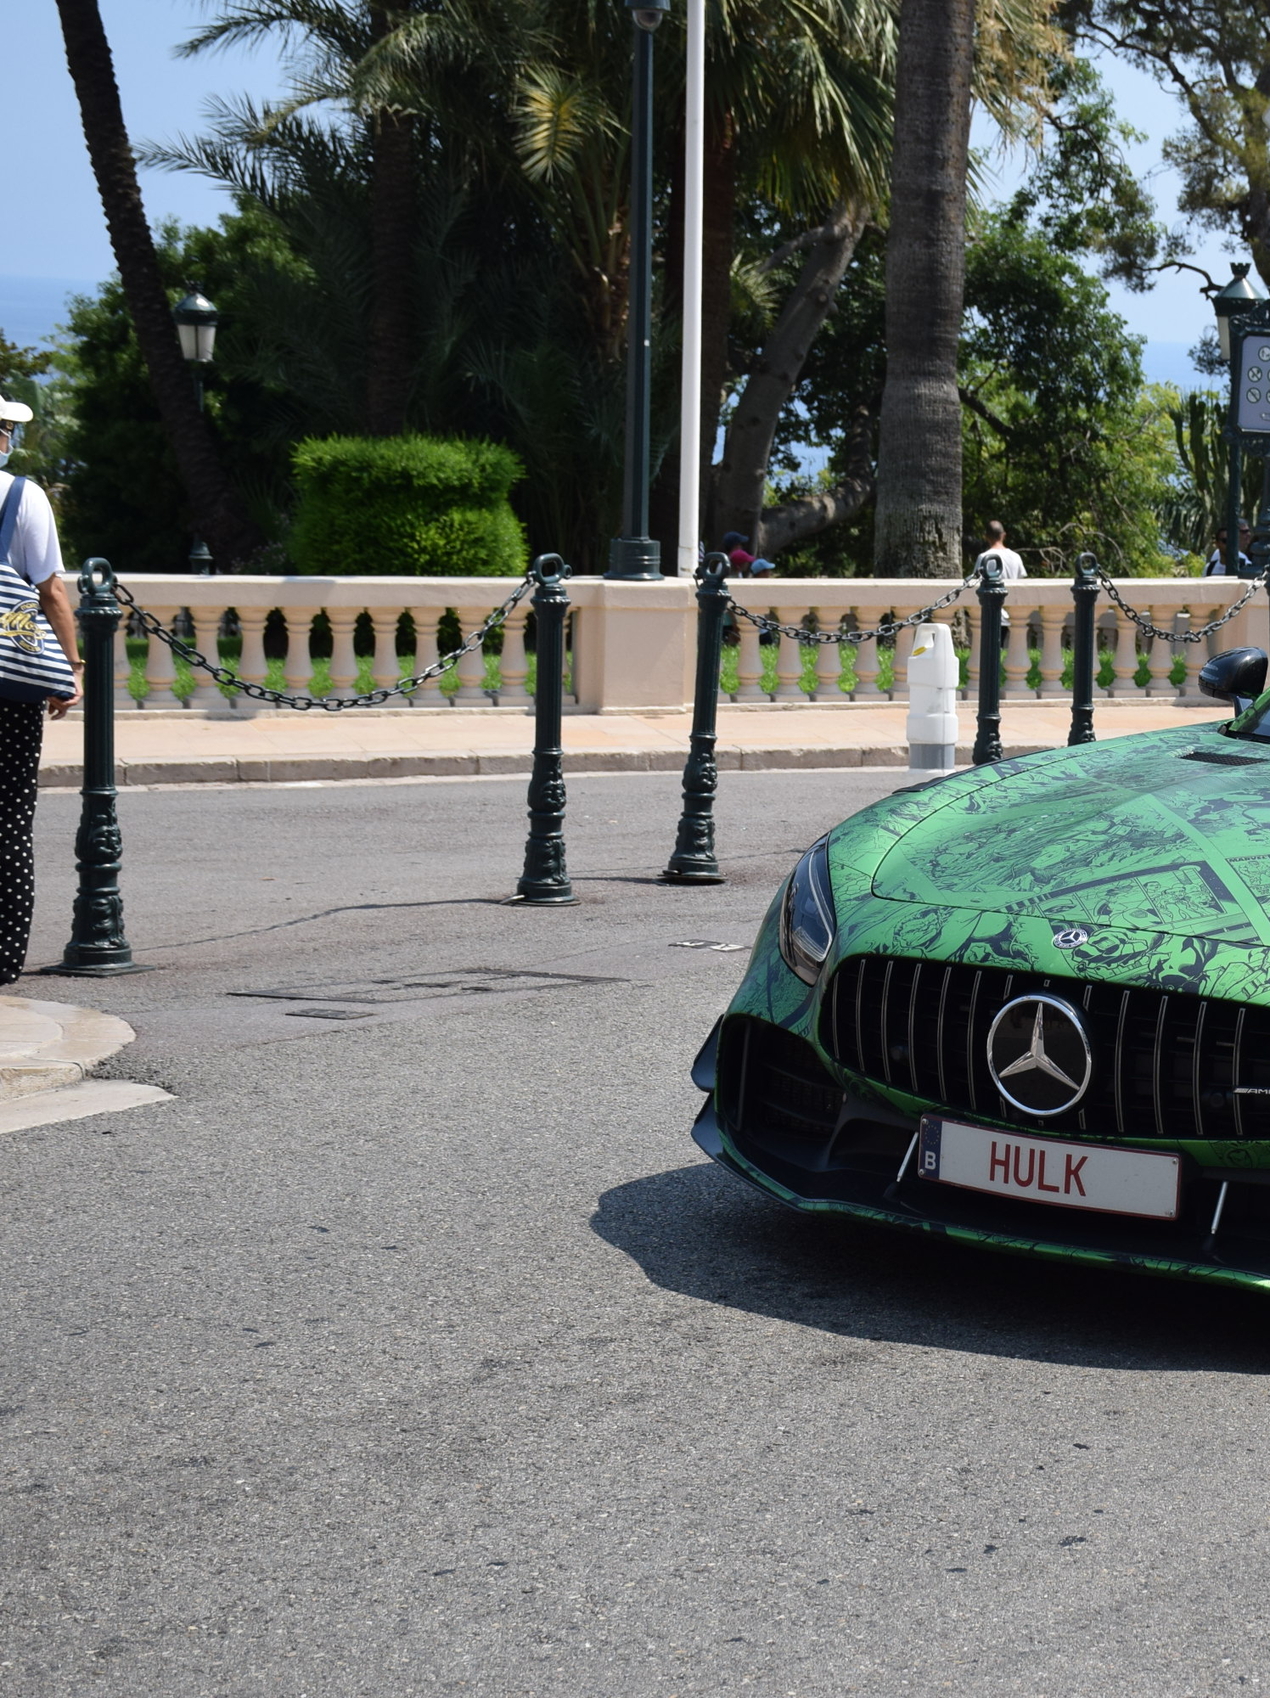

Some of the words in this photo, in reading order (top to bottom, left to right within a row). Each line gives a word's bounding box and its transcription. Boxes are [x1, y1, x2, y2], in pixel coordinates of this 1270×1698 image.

[1228, 855, 1268, 863] MARVEL
[923, 1150, 937, 1171] B
[989, 1141, 1088, 1197] HULK
